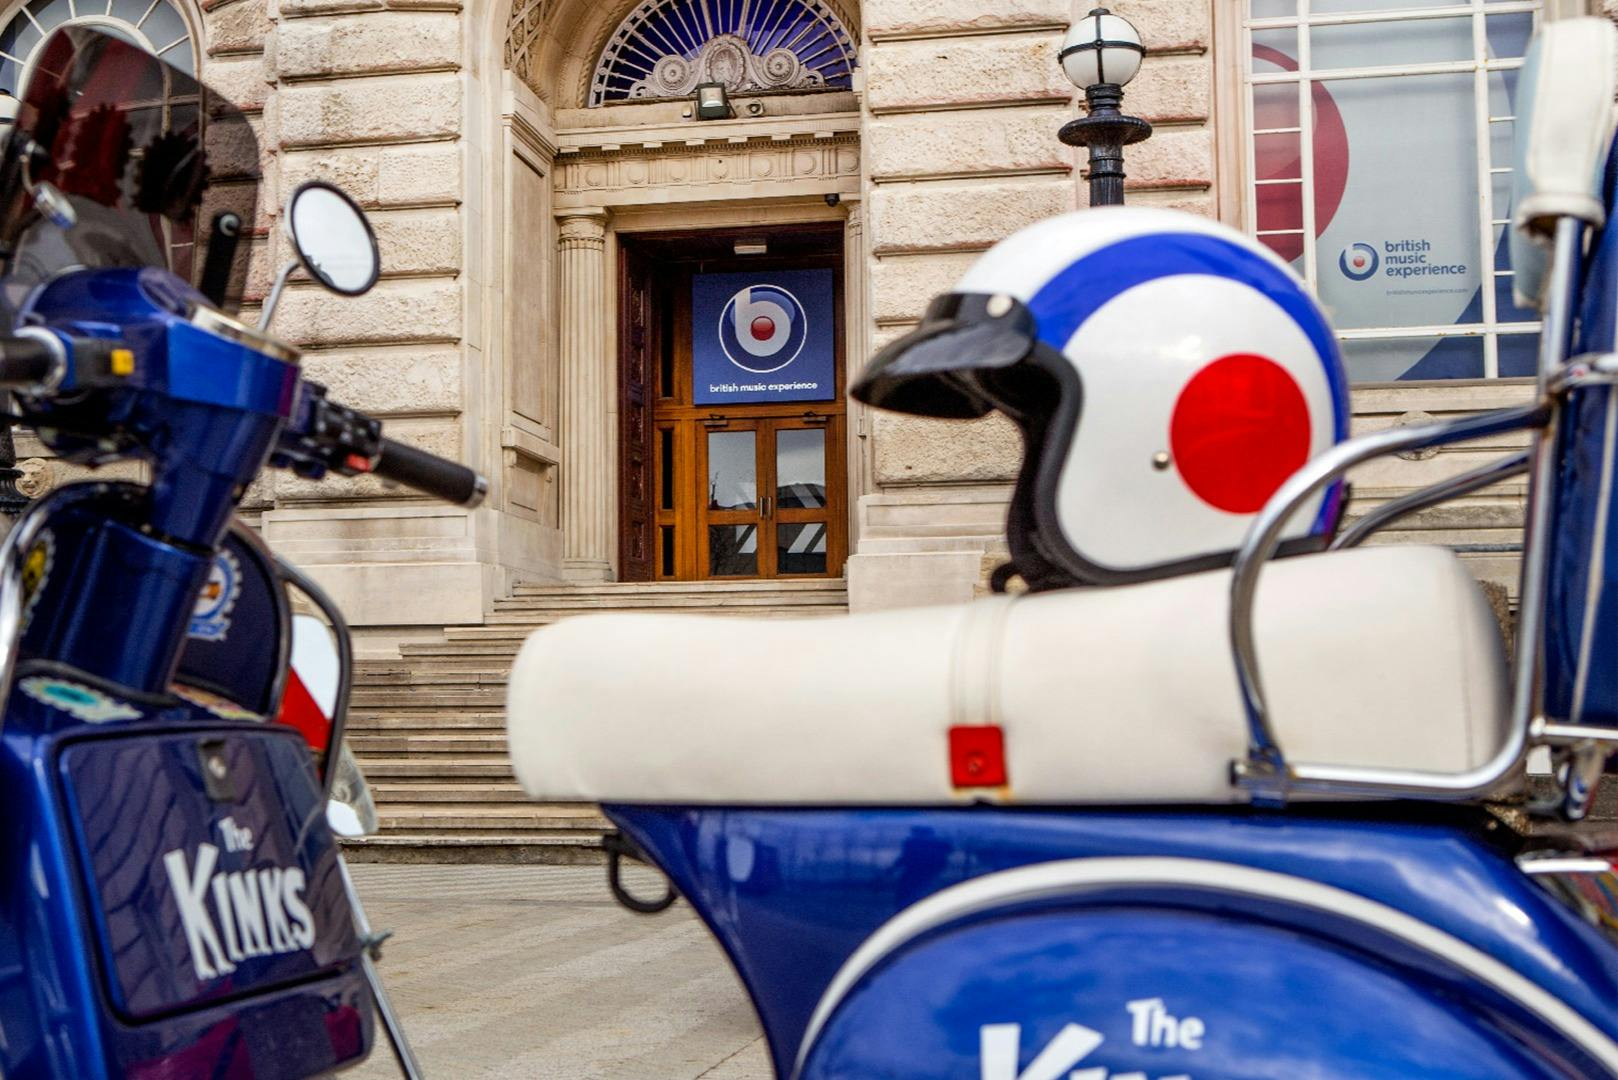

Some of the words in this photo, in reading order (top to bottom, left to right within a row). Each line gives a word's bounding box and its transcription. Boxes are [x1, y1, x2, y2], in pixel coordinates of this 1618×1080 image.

[1385, 239, 1430, 252] british
[1385, 252, 1427, 264] music
[1386, 264, 1466, 278] experience
[709, 383, 739, 392] british
[740, 382, 767, 392] music
[768, 381, 818, 392] experience
[217, 816, 254, 852] The
[1126, 997, 1206, 1050] The
